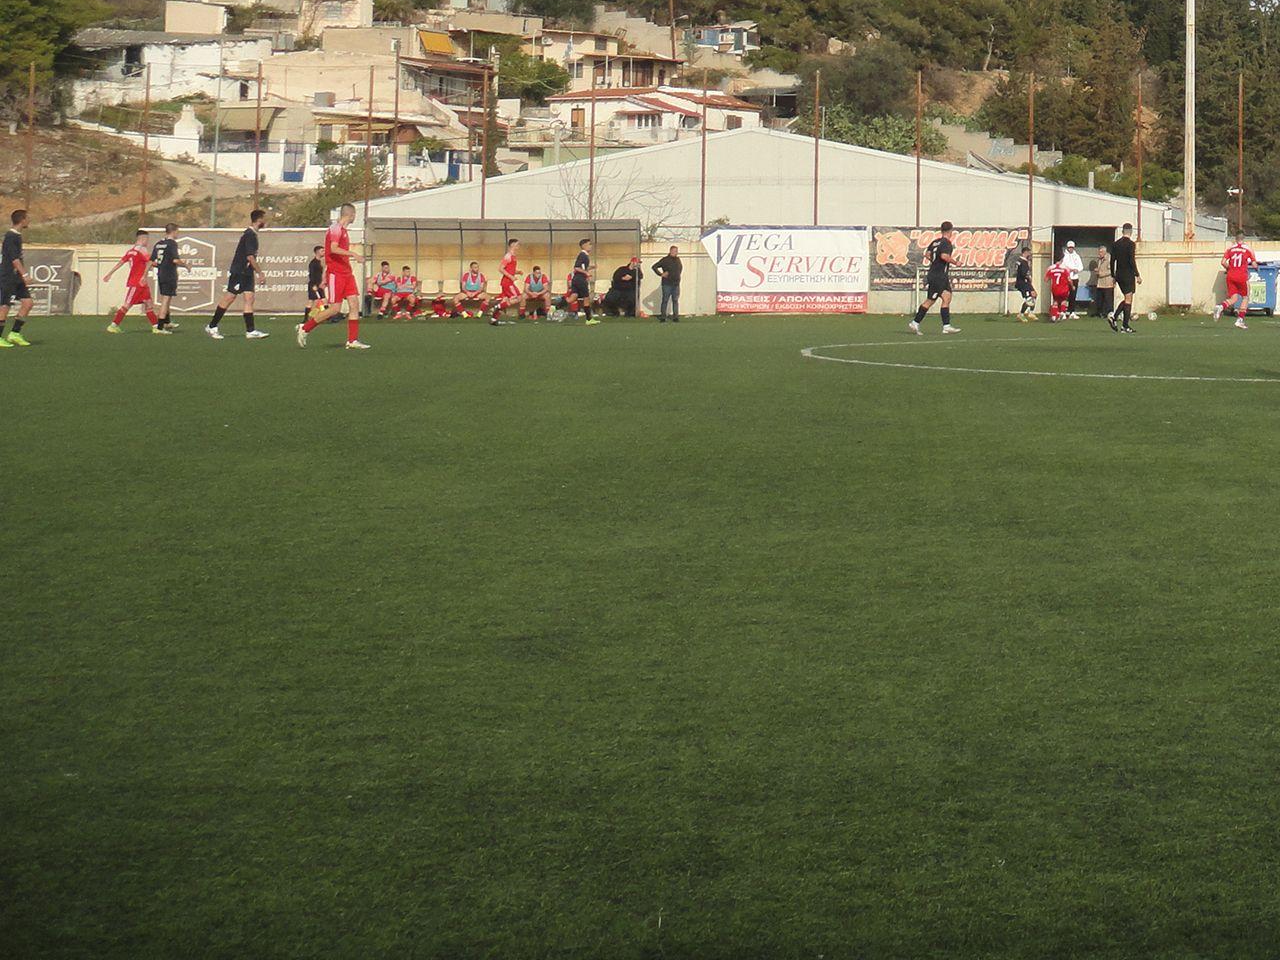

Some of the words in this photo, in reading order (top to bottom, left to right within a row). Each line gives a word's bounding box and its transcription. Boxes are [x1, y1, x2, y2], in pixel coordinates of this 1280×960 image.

[294, 255, 309, 263] 527
[1231, 253, 1243, 268] 11
[740, 255, 863, 288] SERVICE
[767, 274, 826, 284] ΕΞΥΠΗΡΕΤΗΣΗ
[828, 274, 859, 284] ΚΤΙΡΙΩΝ
[1053, 272, 1062, 285] 7
[778, 295, 864, 303] ΑΠΟΛΥΜΑΝΣΕΙΣ
